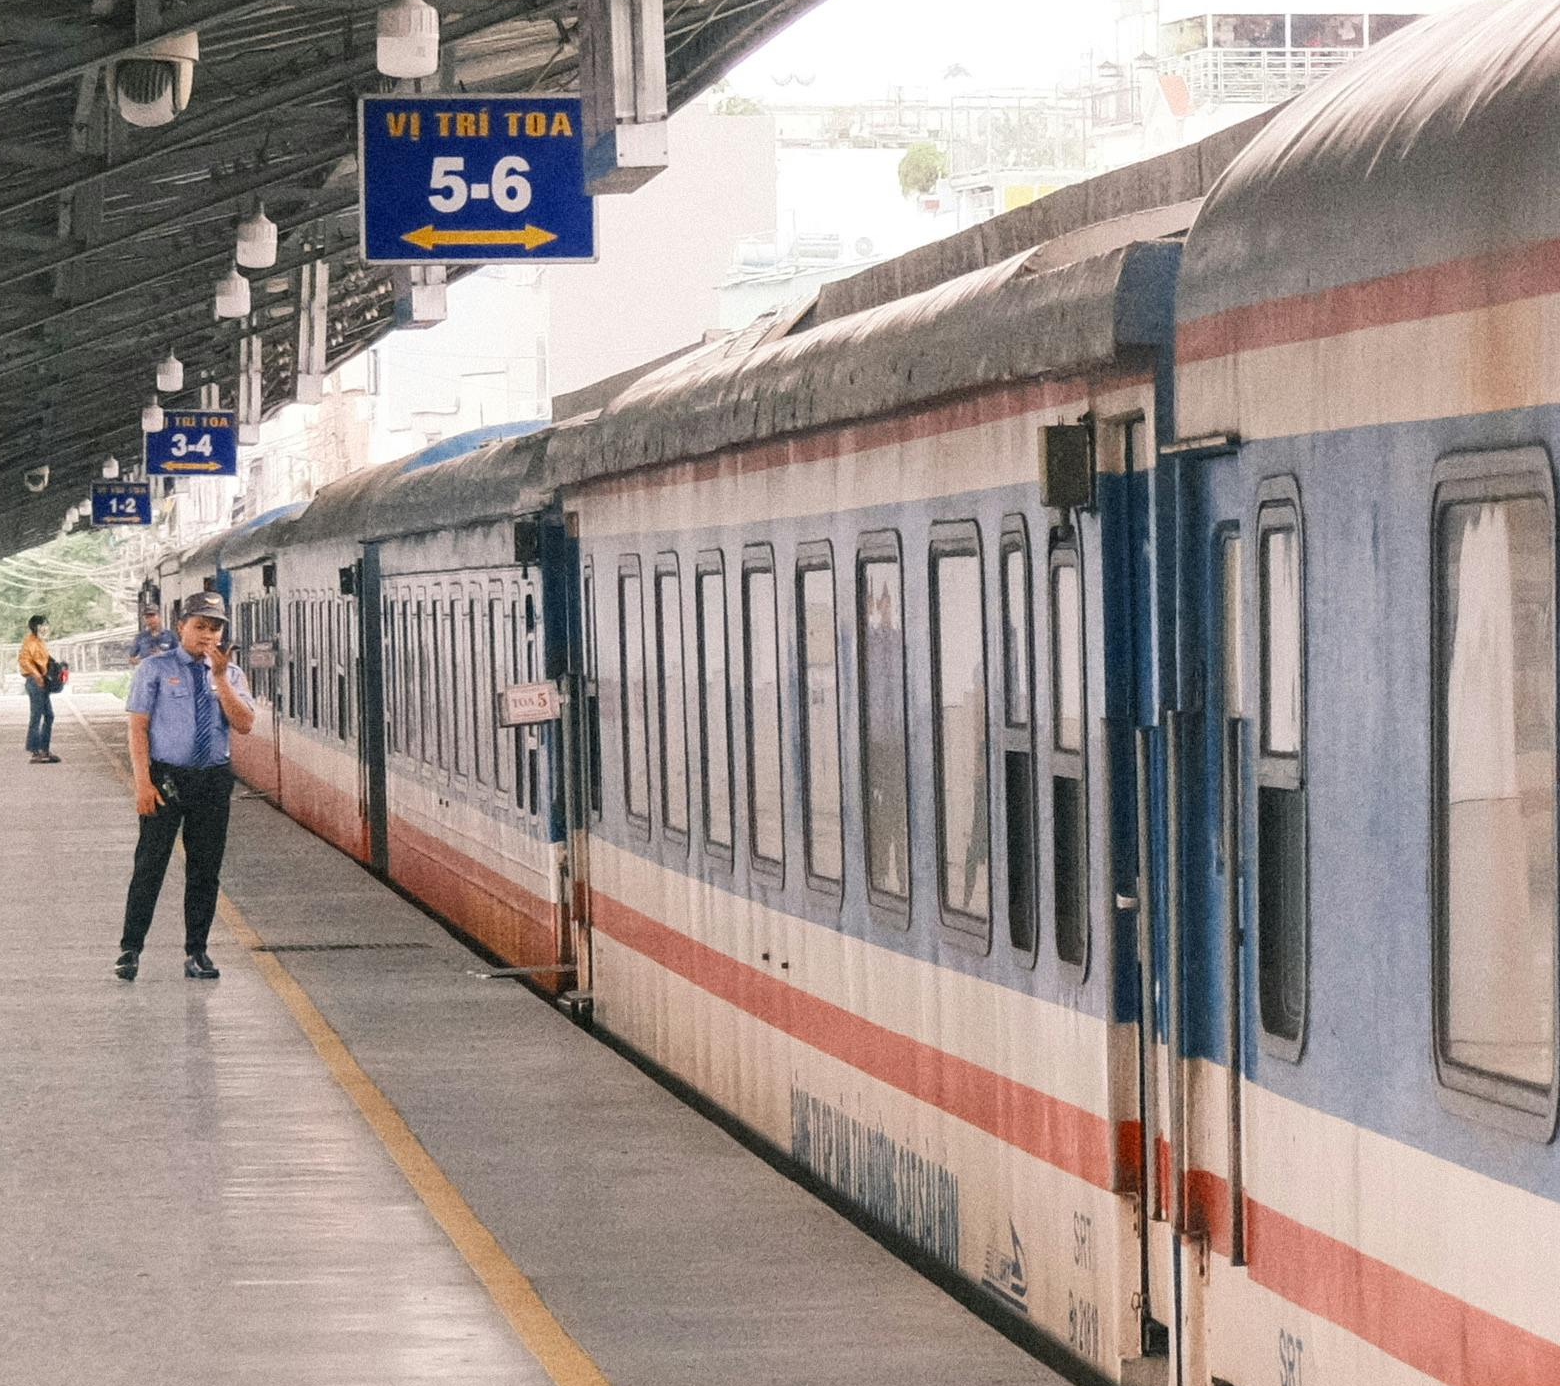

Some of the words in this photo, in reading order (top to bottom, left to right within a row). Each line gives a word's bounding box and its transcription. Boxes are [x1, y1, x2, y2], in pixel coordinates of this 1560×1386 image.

[386, 112, 420, 141] VỊ
[436, 107, 489, 137] TRÍ
[505, 112, 572, 137] TOA
[428, 155, 532, 213] 5-6
[201, 416, 230, 428] TOA
[171, 433, 213, 457] 3-4
[109, 497, 137, 513] 1-2
[537, 692, 548, 708] 5
[1073, 1210, 1092, 1270] SRT
